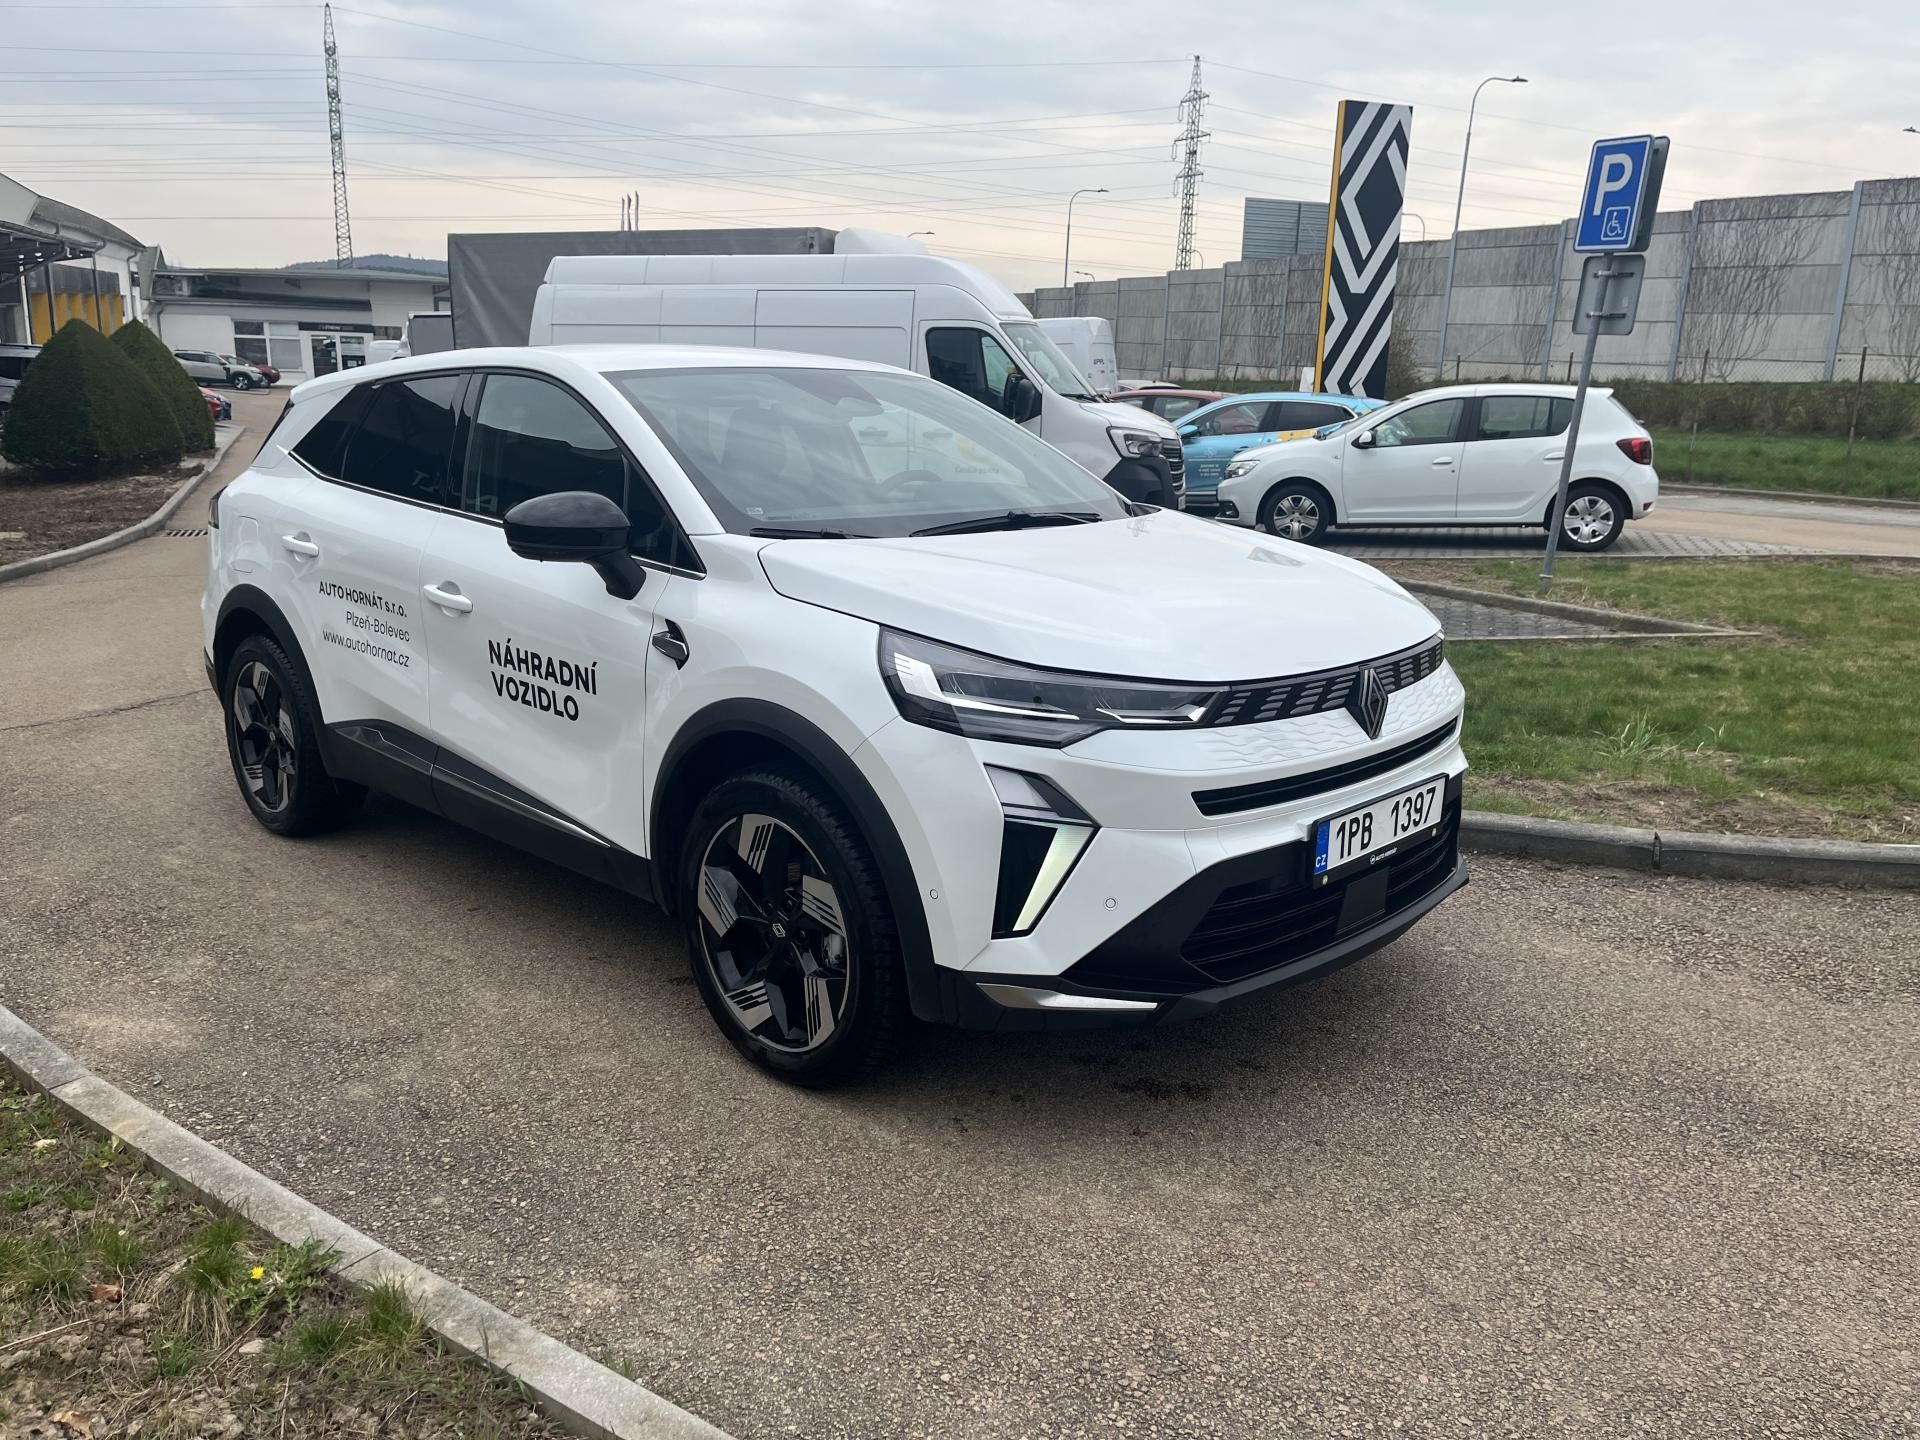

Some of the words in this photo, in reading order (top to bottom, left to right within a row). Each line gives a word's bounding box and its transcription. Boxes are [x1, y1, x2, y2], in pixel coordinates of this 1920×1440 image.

[1593, 153, 1633, 216] P
[319, 581, 345, 599] AUTO
[345, 587, 383, 610] HORNÁT
[384, 601, 408, 618] s.r.o.
[346, 611, 410, 642] Plzeň-Bolevec
[322, 630, 410, 668] www.autohornat.cz
[488, 638, 598, 695] NÁHRADNÍ
[490, 671, 579, 722] VOZIDLO
[1336, 811, 1374, 860] 1PB
[1391, 786, 1437, 837] 1397
[1315, 854, 1327, 868] CZ
